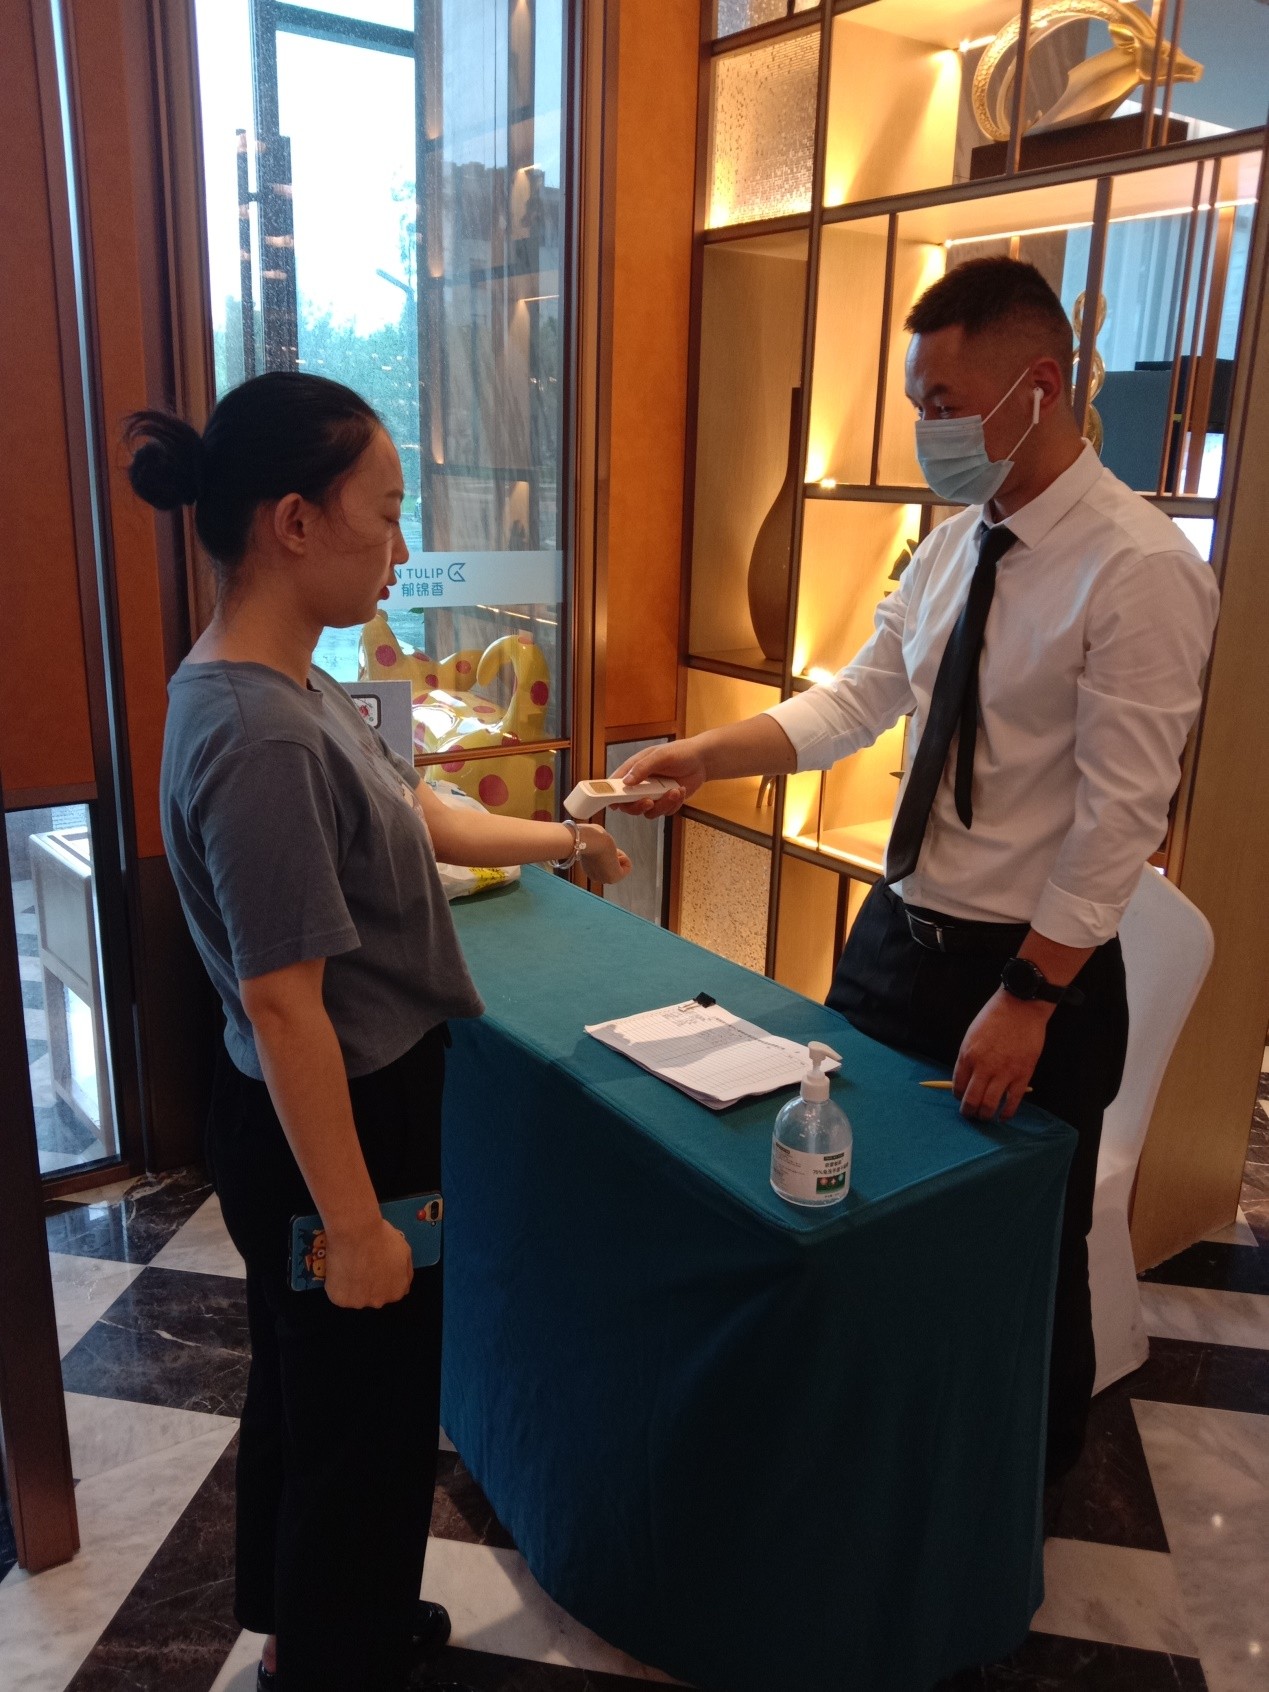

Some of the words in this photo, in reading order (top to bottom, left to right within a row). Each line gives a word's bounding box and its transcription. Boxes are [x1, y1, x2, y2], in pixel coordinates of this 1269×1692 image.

[407, 568, 444, 579] TULIP
[402, 582, 443, 597] 郁锦香
